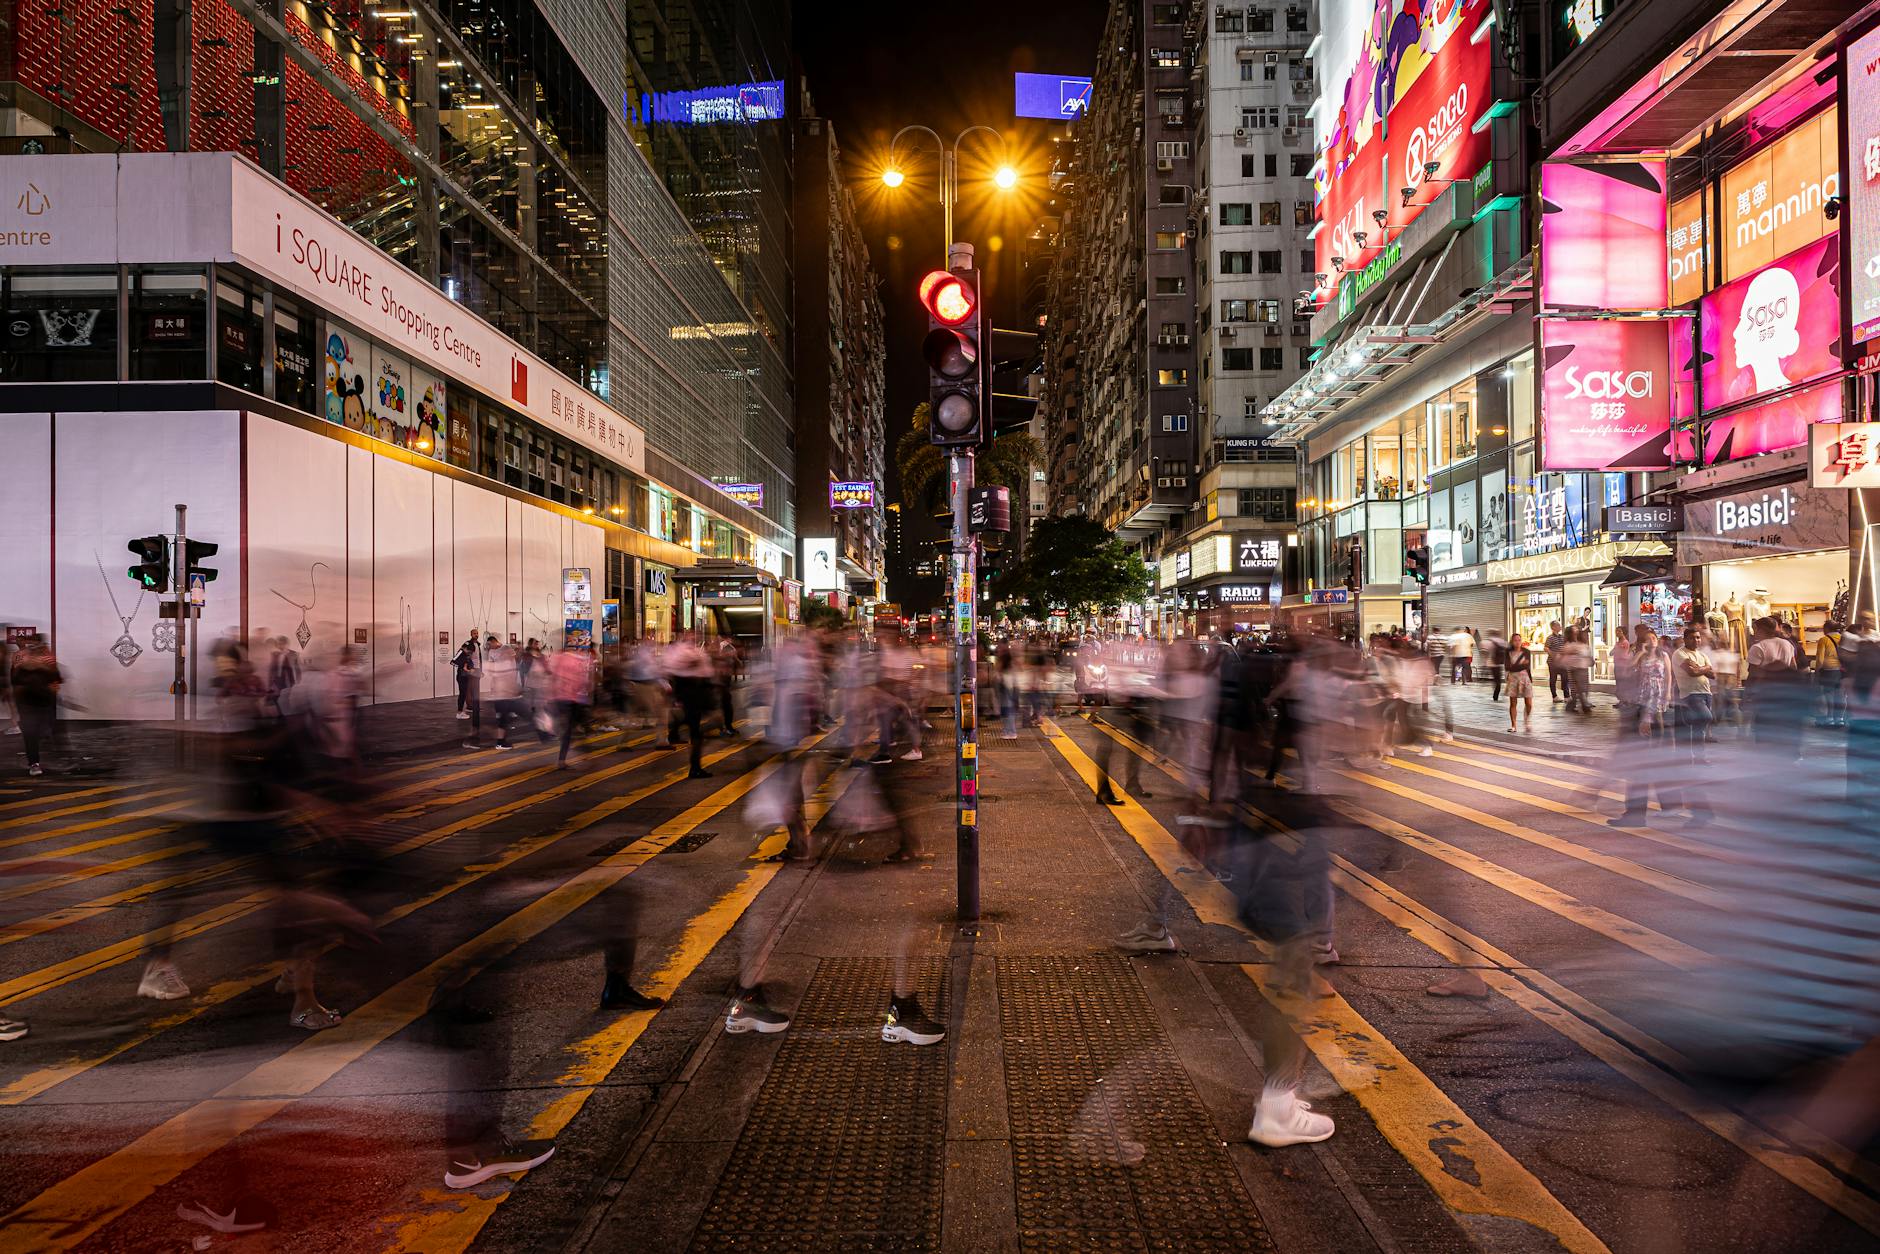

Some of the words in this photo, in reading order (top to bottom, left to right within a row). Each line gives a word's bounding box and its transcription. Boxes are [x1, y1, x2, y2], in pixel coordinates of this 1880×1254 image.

[1062, 97, 1087, 112] AXA
[1427, 82, 1468, 147] SOGO
[1447, 123, 1463, 146] KONG
[17, 182, 52, 216] 心
[1737, 180, 1768, 220] 萬寧
[1356, 255, 1387, 298] Holiday
[1386, 243, 1401, 272] Inn
[276, 213, 282, 255] i
[291, 228, 374, 307] SQUARE
[382, 285, 441, 352] Shopping
[442, 325, 482, 369] Centre
[154, 318, 186, 330] 周大福
[380, 358, 401, 384] Disney
[1590, 401, 1626, 421] 莎莎
[551, 387, 635, 460] 國際廣場購物中心
[1569, 424, 1597, 436] making
[1597, 422, 1612, 437] life
[1612, 422, 1648, 436] beautiful
[1226, 439, 1247, 447] KUNG
[1248, 439, 1258, 447] FU
[1523, 486, 1566, 536] 金至尊
[1240, 540, 1280, 559] 六福
[1732, 537, 1758, 551] design
[1766, 533, 1783, 546] life
[650, 569, 667, 596] M&S
[1221, 587, 1261, 597] RADO
